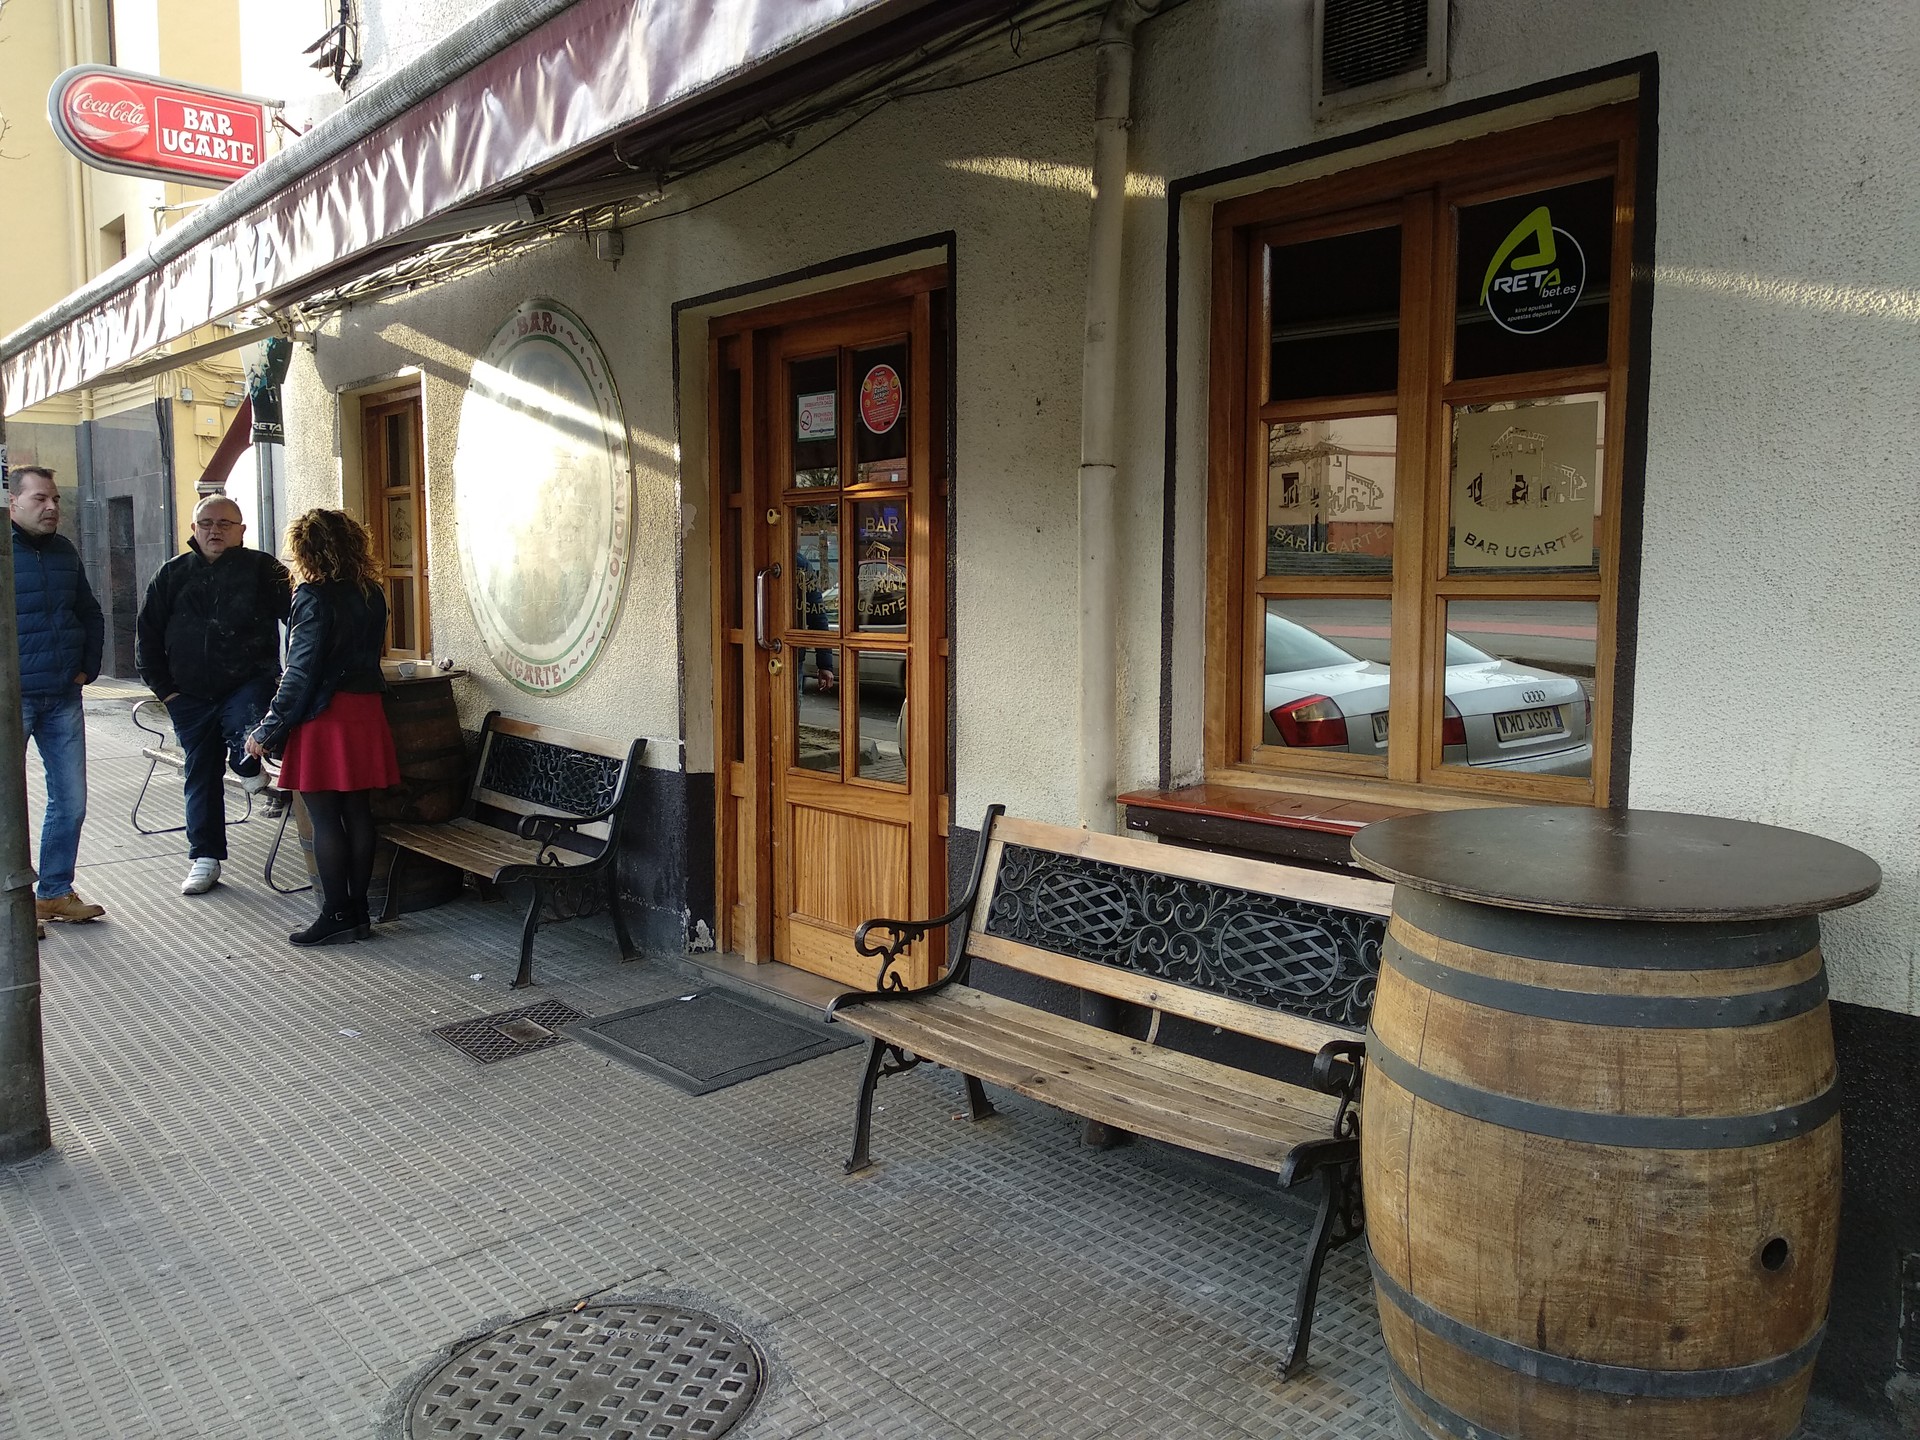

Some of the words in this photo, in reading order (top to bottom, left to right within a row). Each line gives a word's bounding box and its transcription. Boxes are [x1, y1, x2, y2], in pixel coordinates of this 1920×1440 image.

[73, 91, 145, 125] Coca-Cola
[183, 106, 233, 137] BAR
[162, 128, 255, 165] UGARTE
[1541, 284, 1577, 298] bet.es
[516, 311, 557, 338] BAR
[1507, 313, 1532, 322] apuestas
[1532, 309, 1561, 319] deportivas
[865, 517, 898, 533] BAR
[1274, 527, 1308, 551] BAR
[1313, 524, 1387, 554] UGARTE
[1464, 532, 1499, 555] BAR
[1505, 528, 1584, 558] UGARTE
[857, 596, 907, 617] UGARTE
[504, 651, 561, 687] UGARTE
